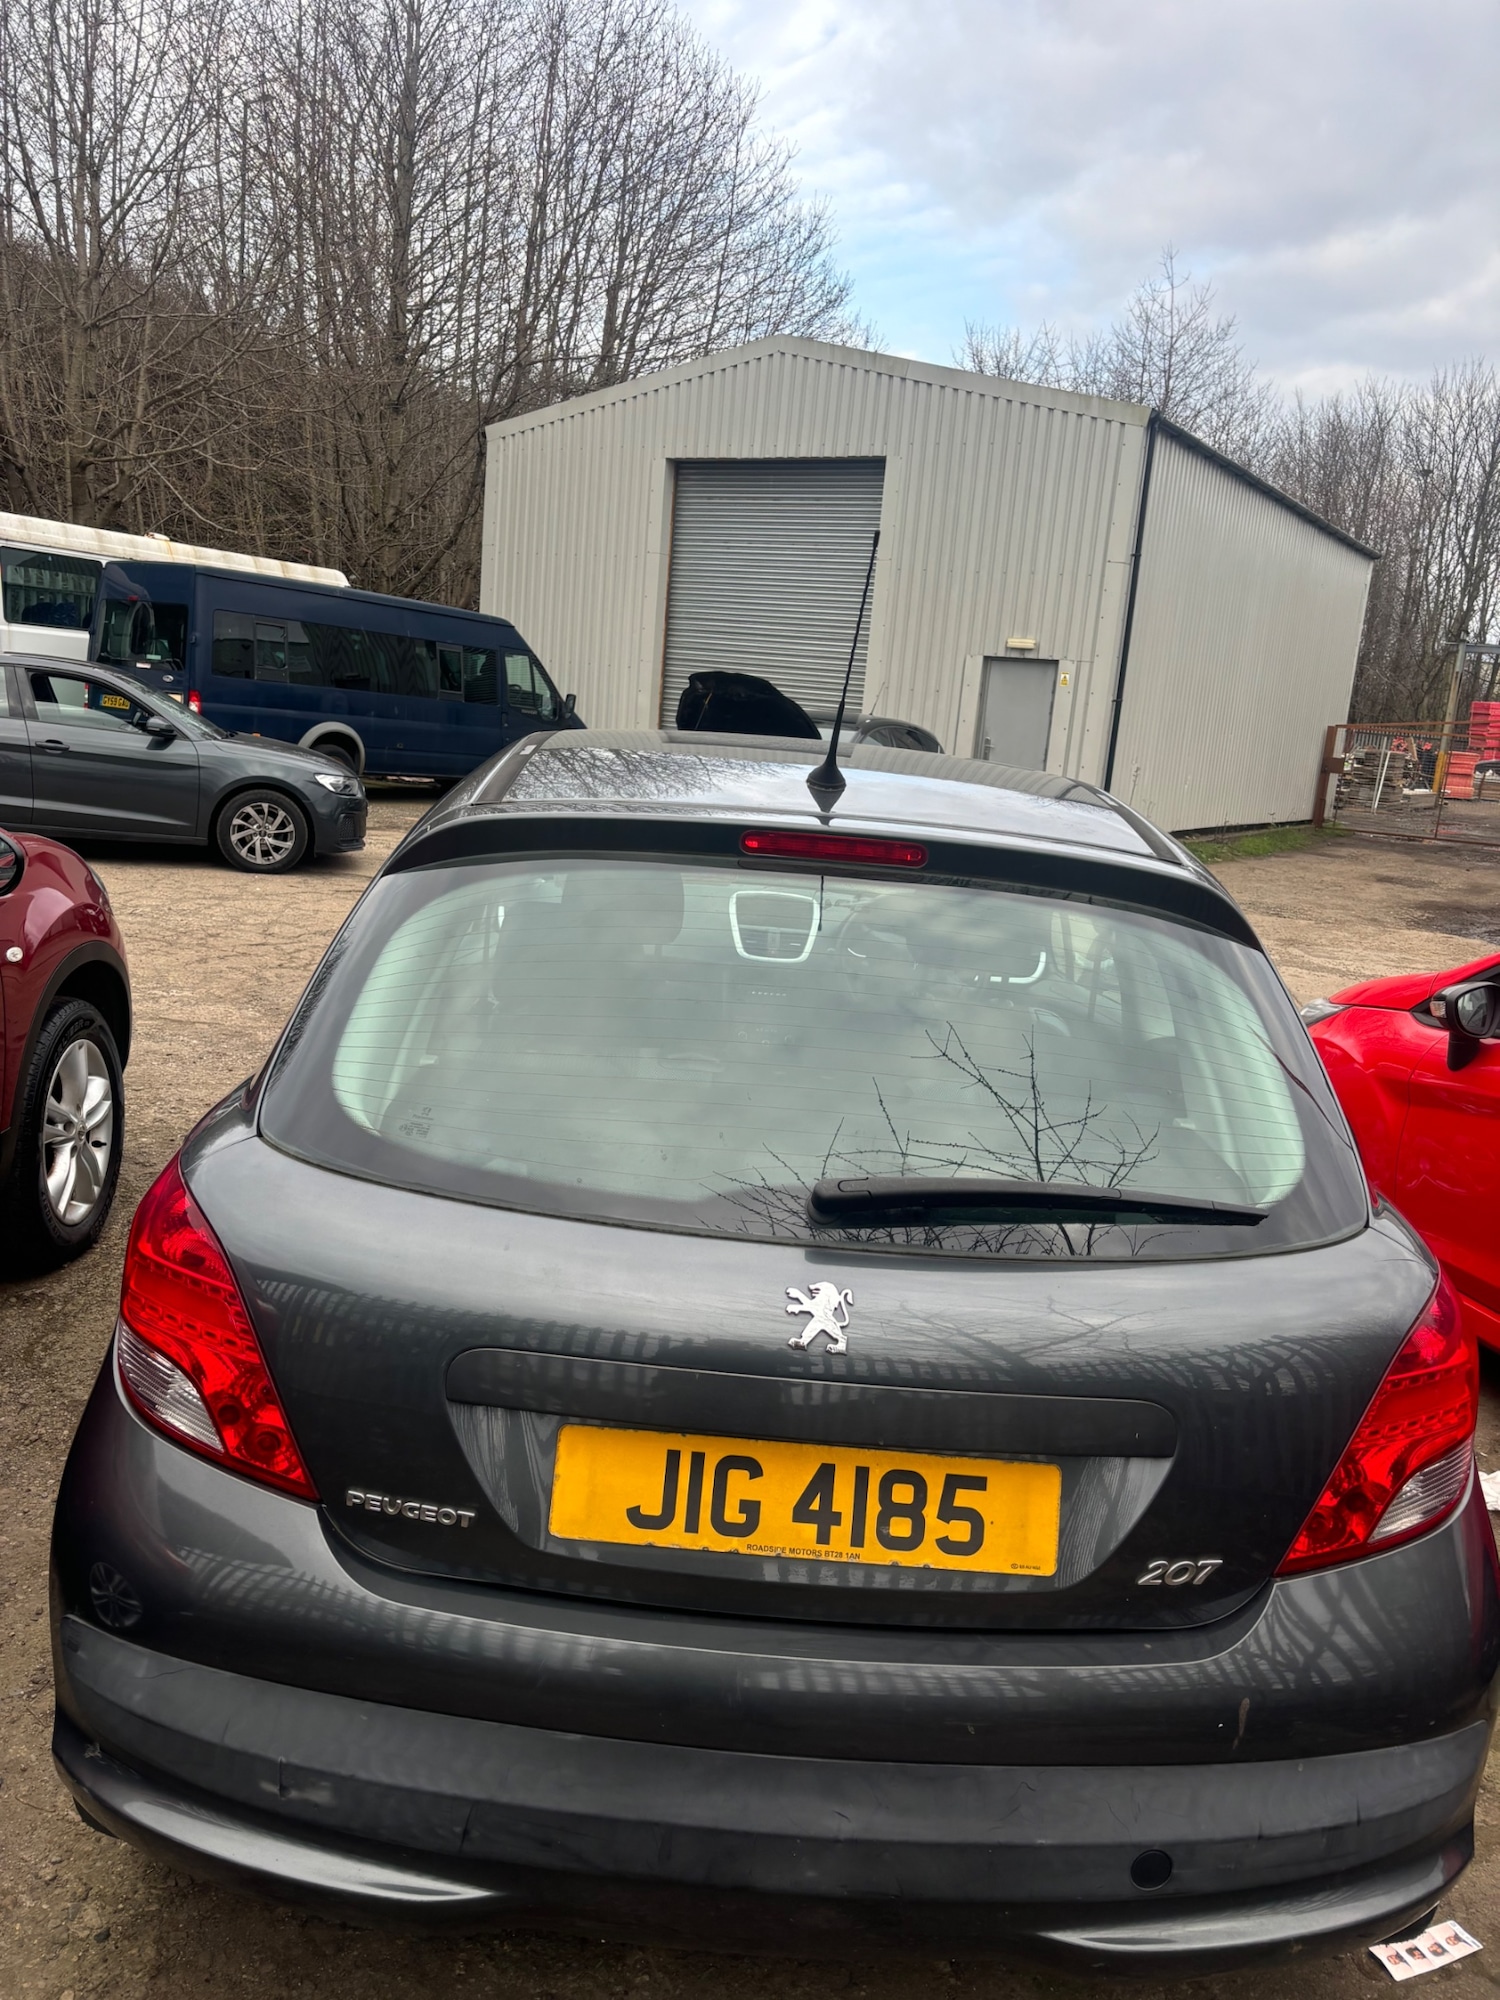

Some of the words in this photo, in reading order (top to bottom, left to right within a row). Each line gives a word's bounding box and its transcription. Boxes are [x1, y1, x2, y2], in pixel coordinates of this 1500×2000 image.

[346, 1490, 476, 1528] PEUGEOT
[626, 1448, 764, 1538] JIG
[792, 1462, 988, 1557] 4185
[746, 1543, 787, 1553] ROADSIDE
[788, 1547, 822, 1557] MOTORS
[824, 1550, 843, 1559] BT28
[845, 1552, 861, 1560] 1AN
[1137, 1560, 1224, 1586] 207
